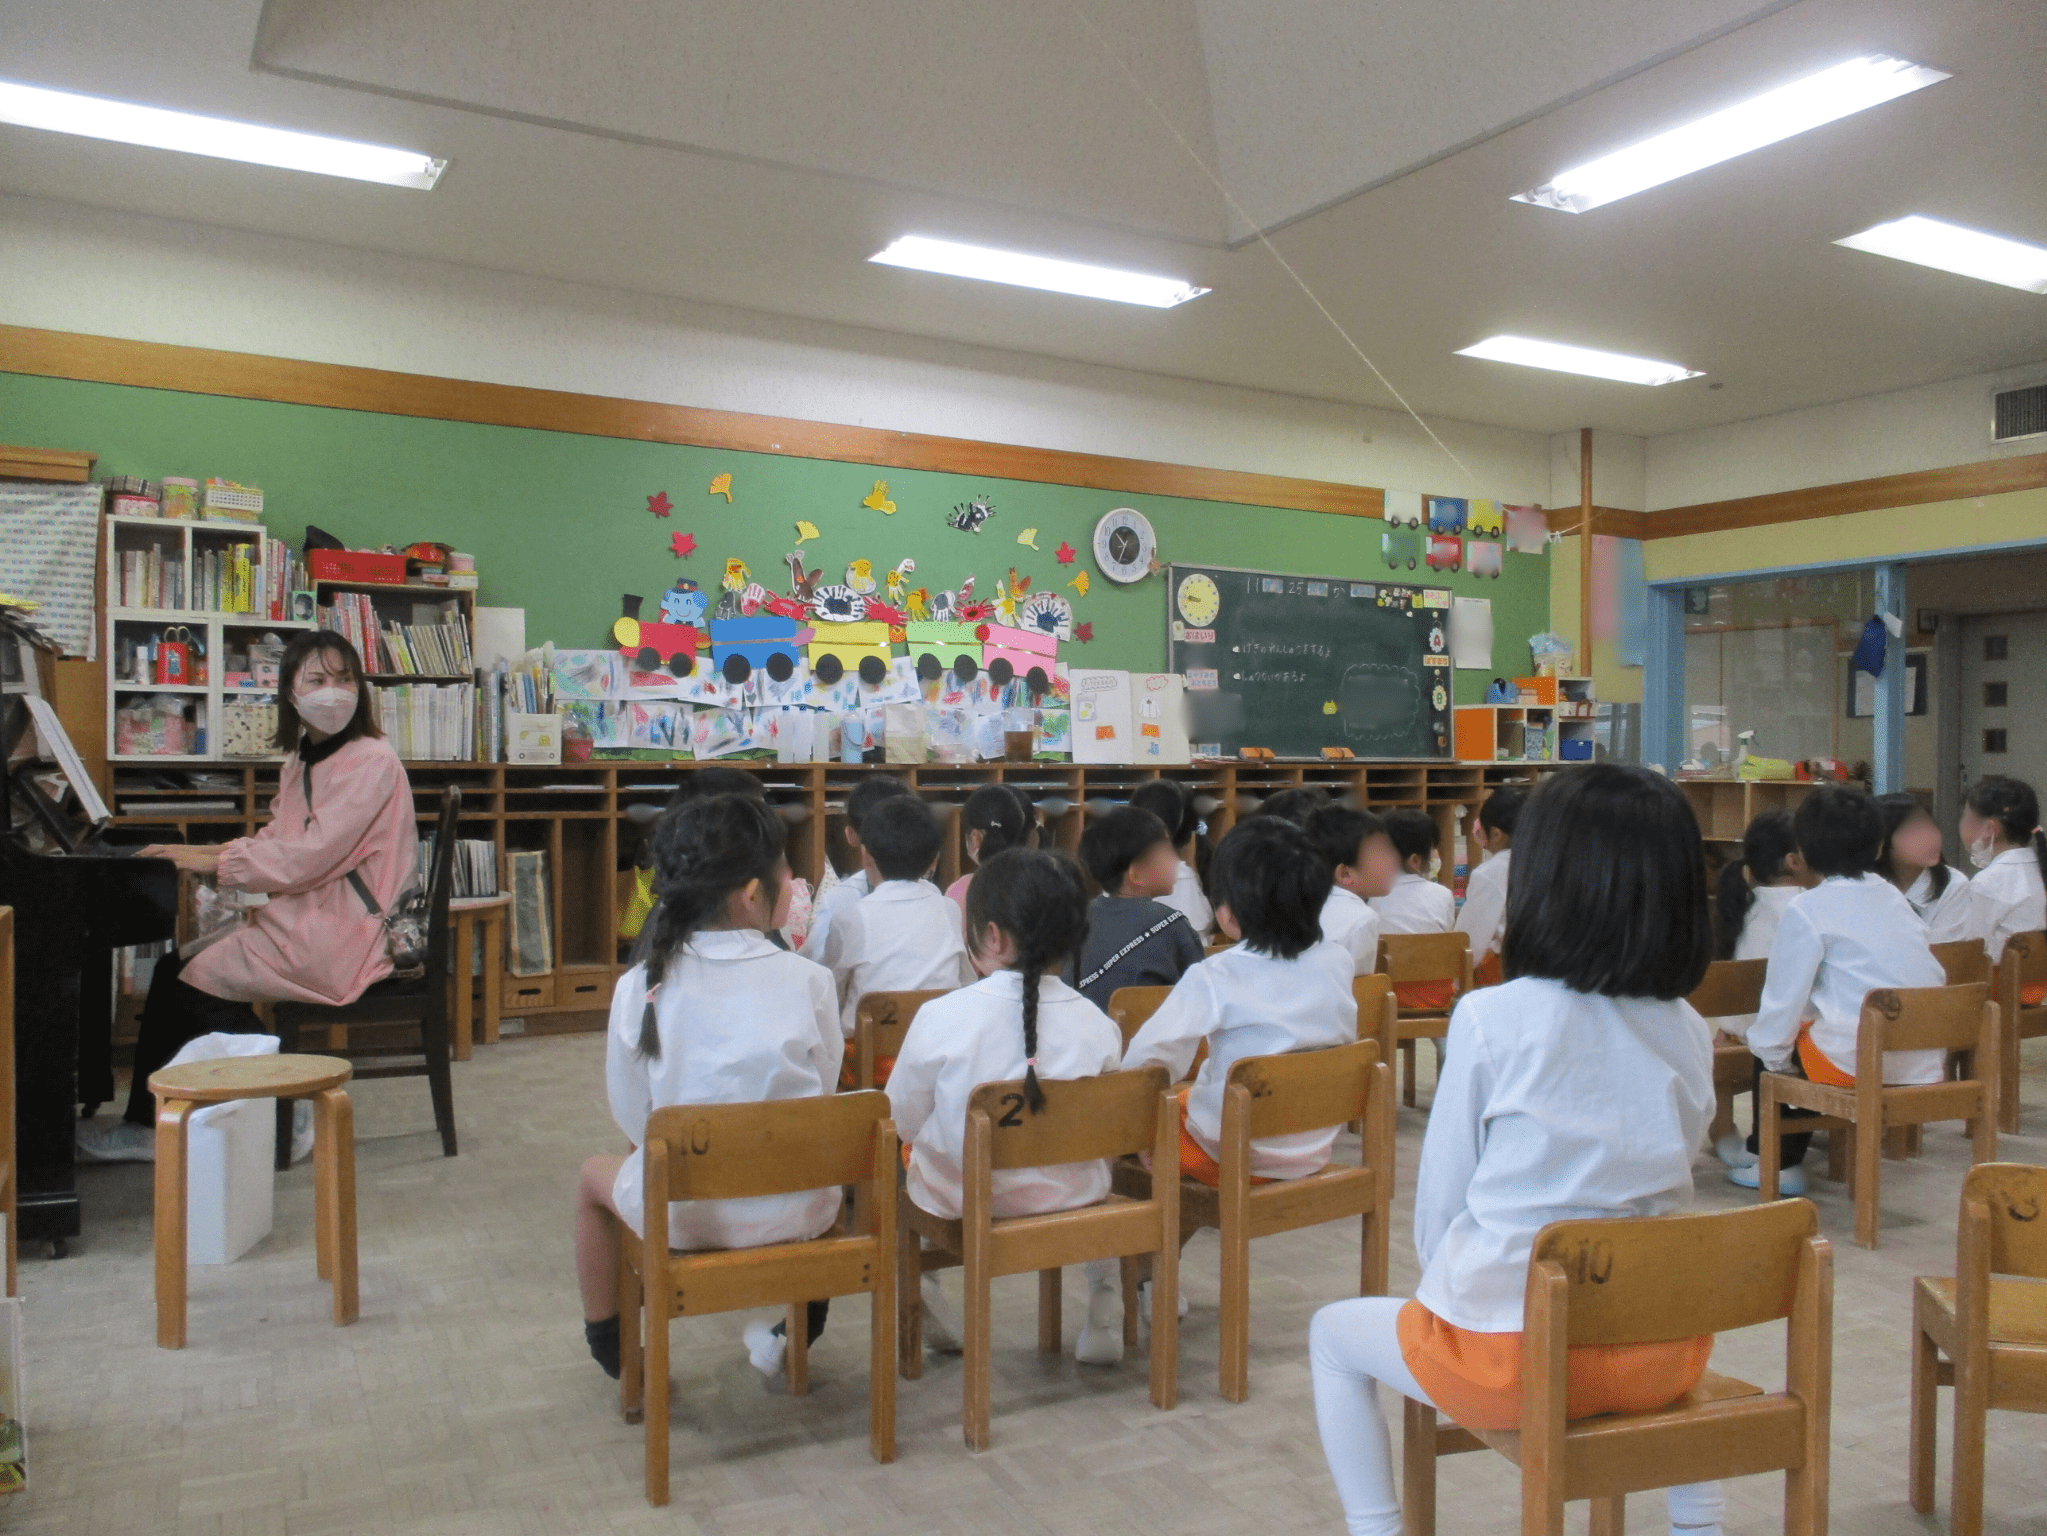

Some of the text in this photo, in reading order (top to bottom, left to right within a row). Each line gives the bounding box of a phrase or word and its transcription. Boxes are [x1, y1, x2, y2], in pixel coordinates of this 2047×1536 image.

[1288, 581, 1304, 595] 25
[1185, 631, 1214, 640] おはいり
[1433, 634, 1441, 647] A
[1436, 692, 1443, 705] B
[1103, 953, 1121, 970] SUPER
[1119, 935, 1145, 957] EXPRESS
[1150, 919, 1169, 934] SUPER
[998, 1093, 1026, 1127] 2
